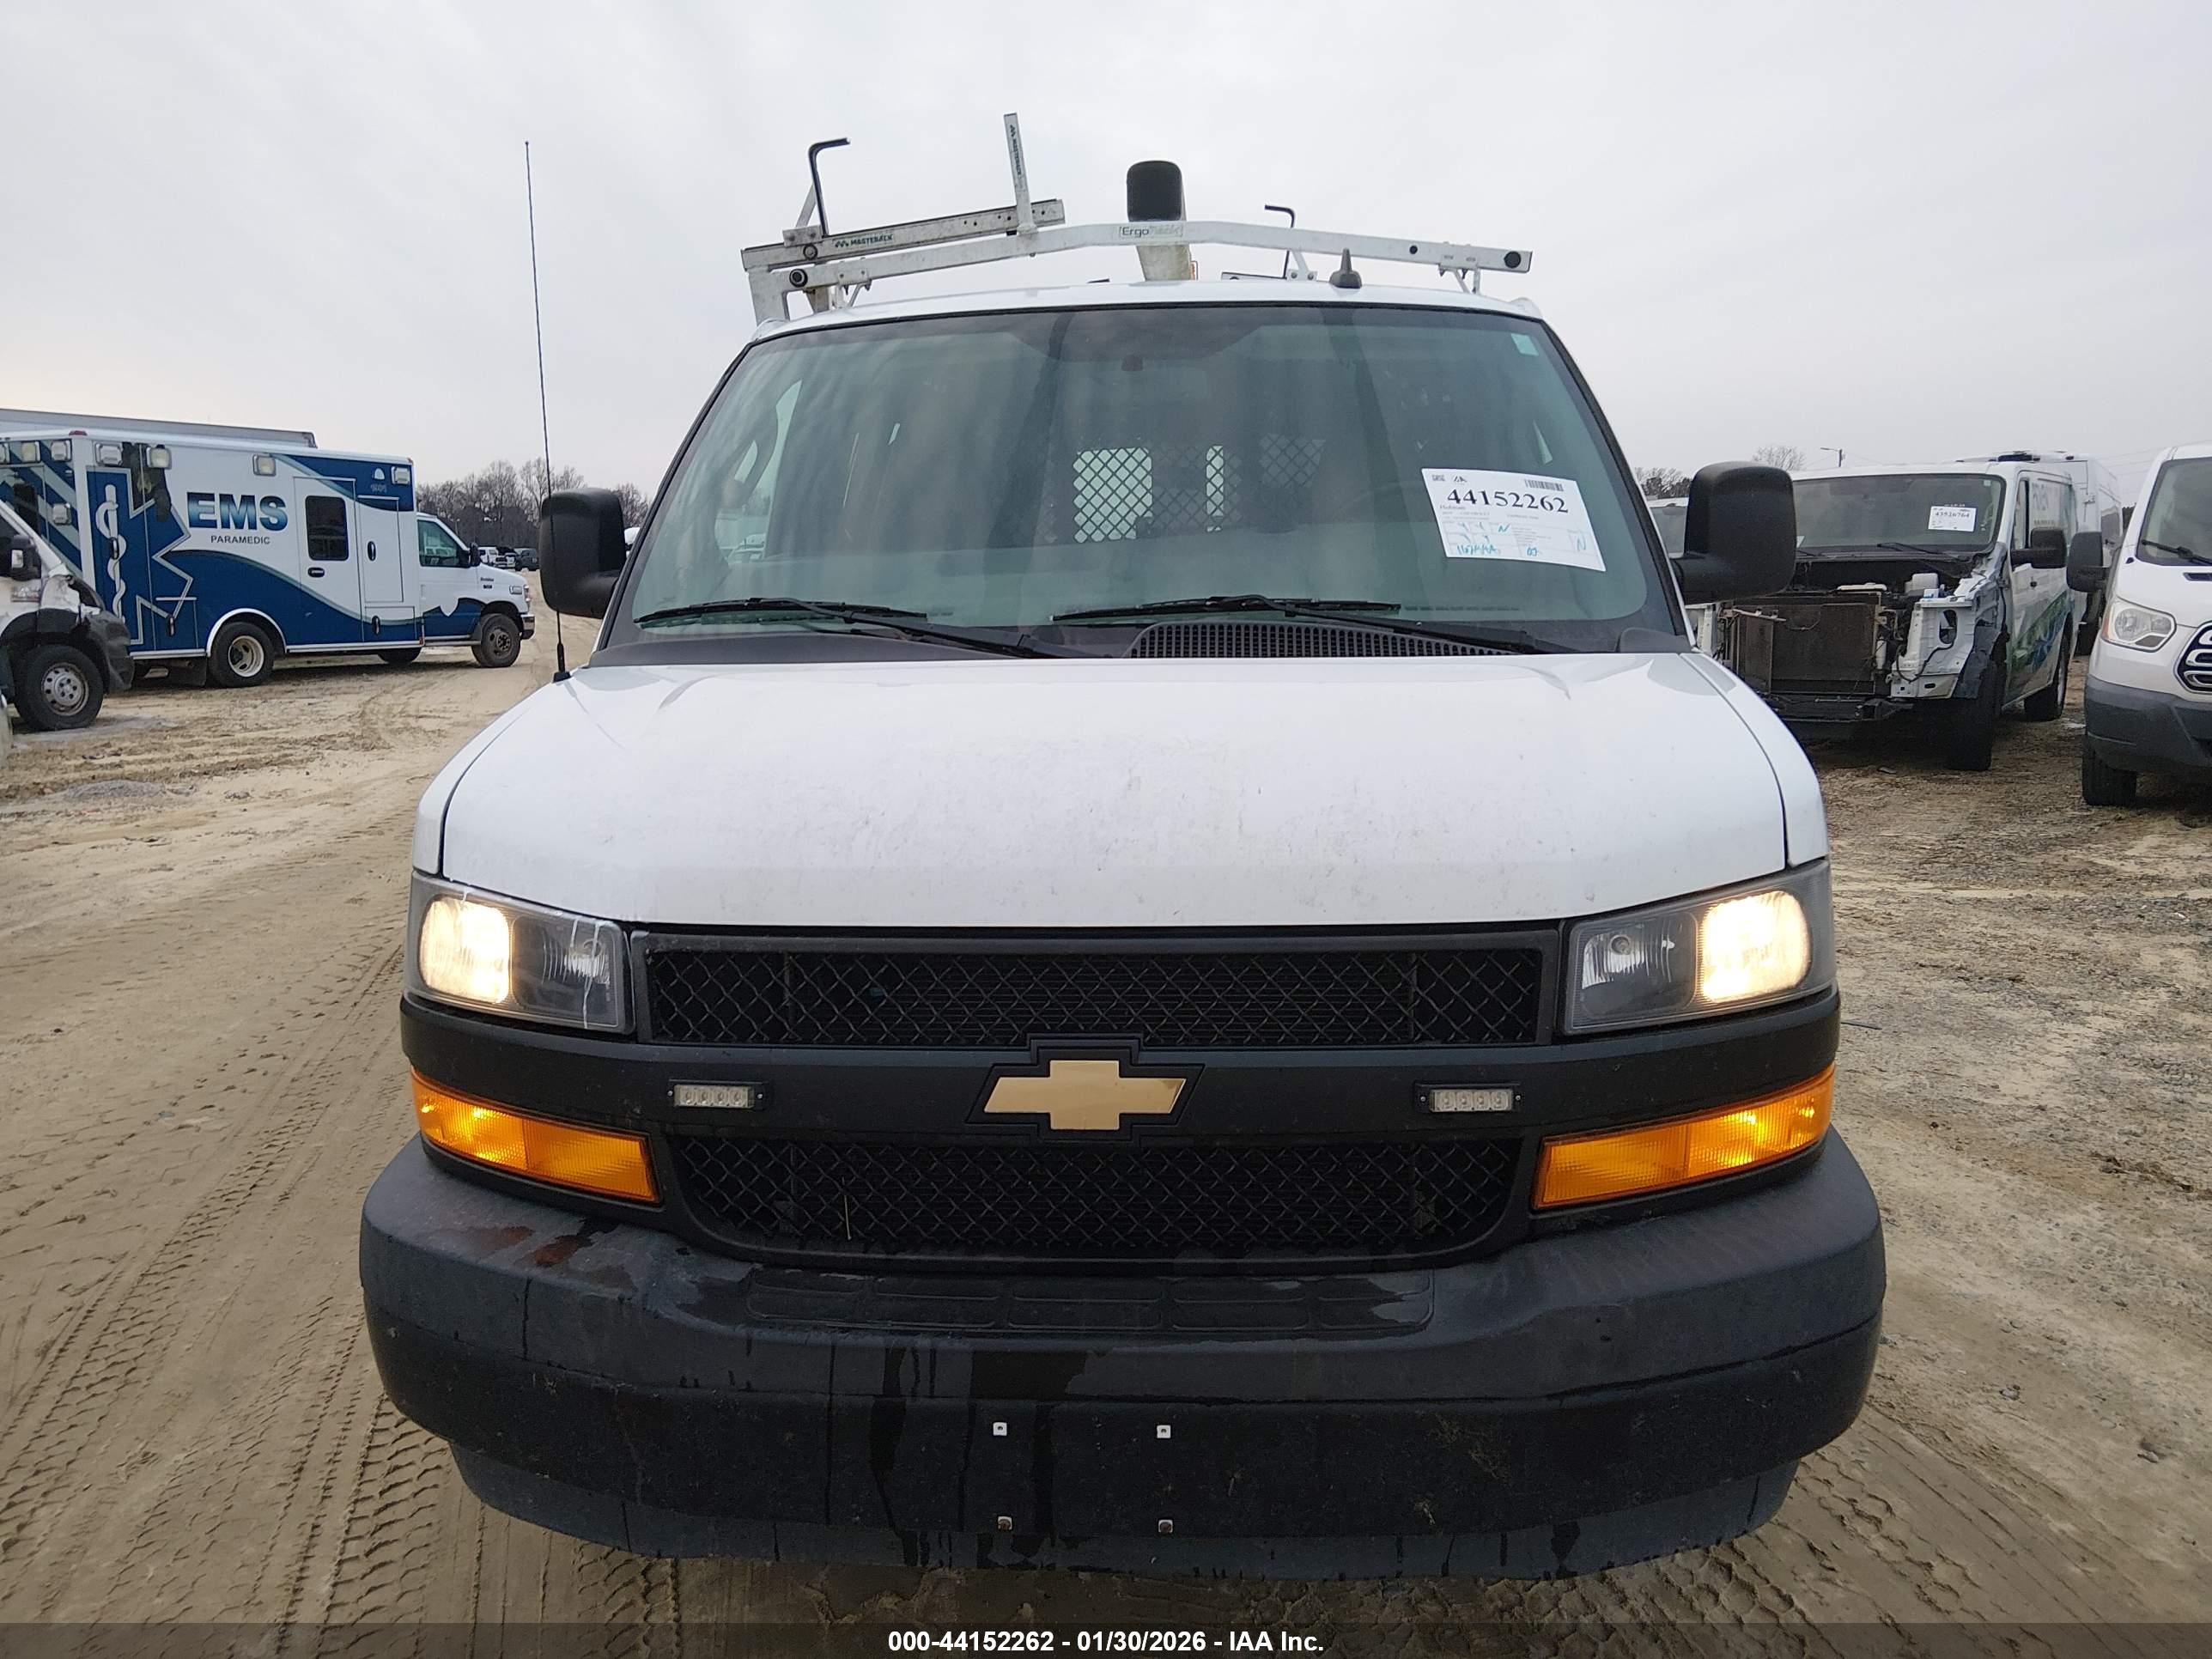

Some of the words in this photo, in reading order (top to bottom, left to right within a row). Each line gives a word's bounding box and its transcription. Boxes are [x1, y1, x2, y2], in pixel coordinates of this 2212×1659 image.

[186, 491, 289, 532] EMS
[1447, 489, 1569, 514] 44152262
[210, 535, 270, 544] PARAMEDIC
